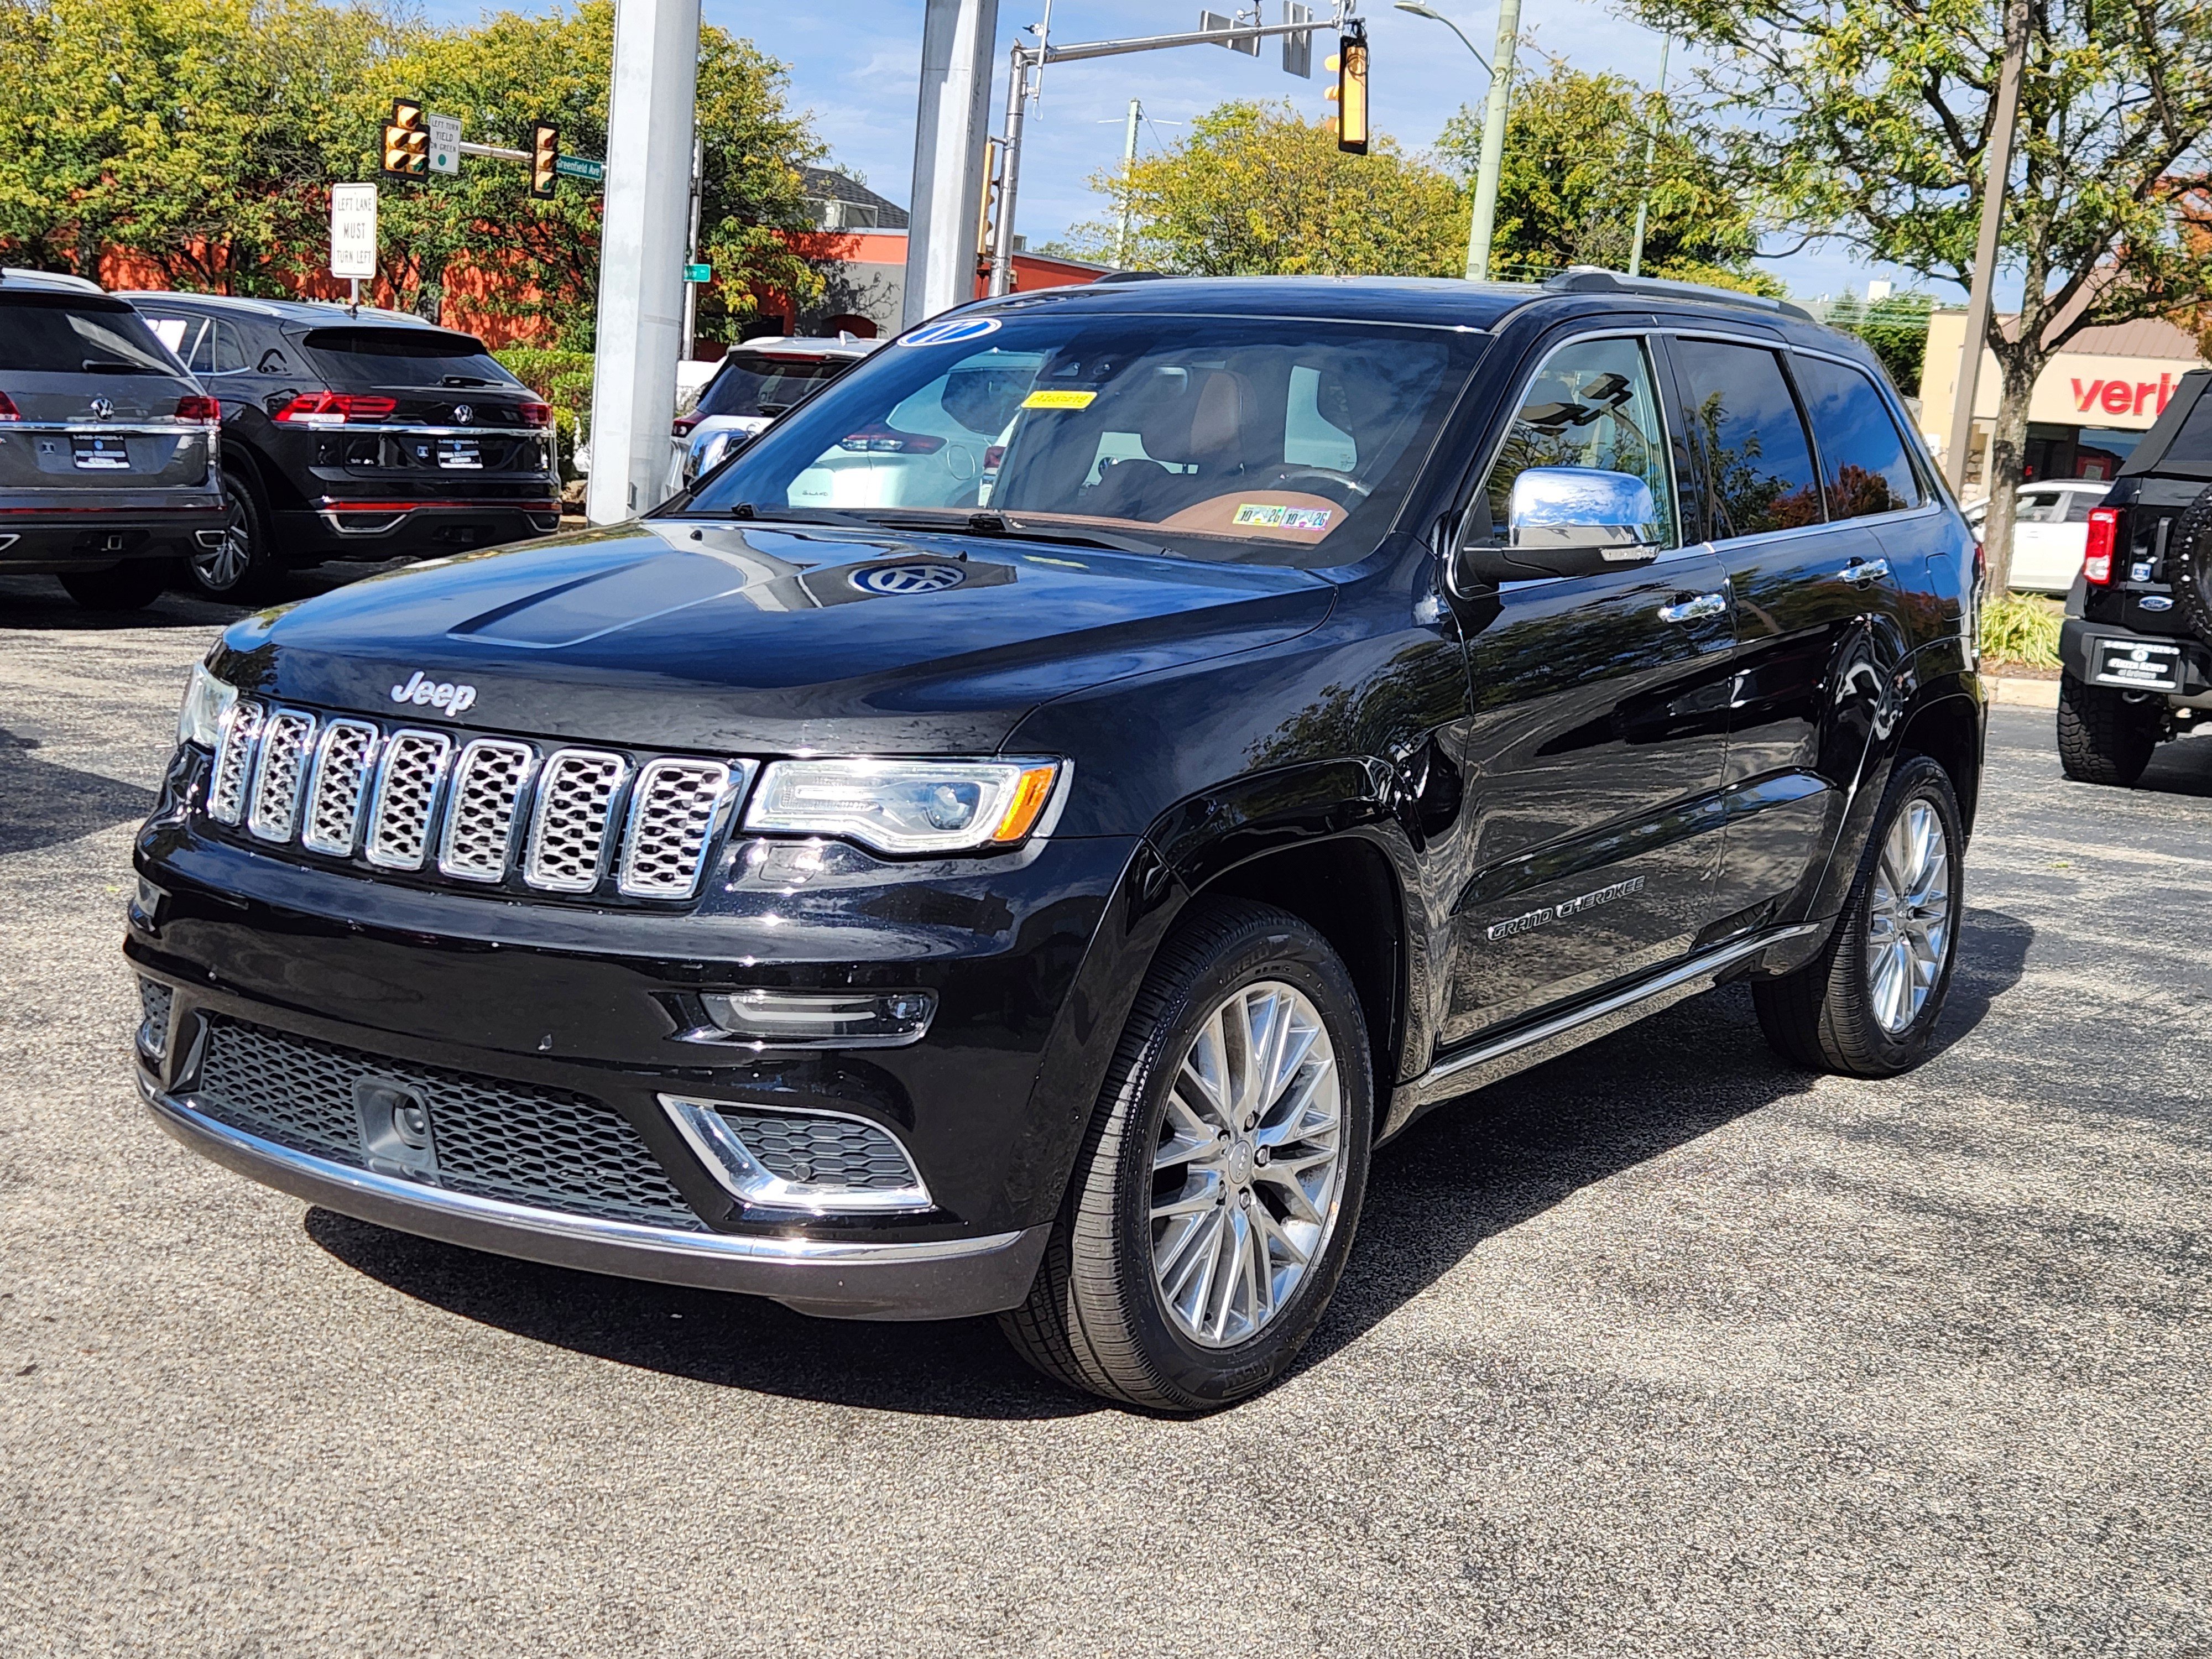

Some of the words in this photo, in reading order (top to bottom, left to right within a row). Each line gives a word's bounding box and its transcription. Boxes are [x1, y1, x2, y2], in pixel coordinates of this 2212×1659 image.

[432, 119, 444, 128] LEFT
[446, 122, 458, 131] TURN
[436, 131, 453, 142] YIELD
[439, 143, 456, 153] GREEN
[556, 156, 588, 174] Greenfield
[588, 164, 600, 176] Ave
[338, 197, 353, 211] LEFT
[356, 197, 372, 211] LANE
[343, 222, 365, 239] MUST
[337, 250, 353, 263] TURN
[357, 251, 371, 263] LEFT
[2070, 373, 2179, 416] veri
[1240, 510, 1253, 521] 10
[1267, 509, 1281, 523] 26
[1286, 513, 1299, 525] 10
[1313, 512, 1327, 526] 26
[390, 671, 477, 717] Jeep
[1487, 907, 1553, 941] GRAND
[1556, 875, 1645, 919] CHEROKEE
